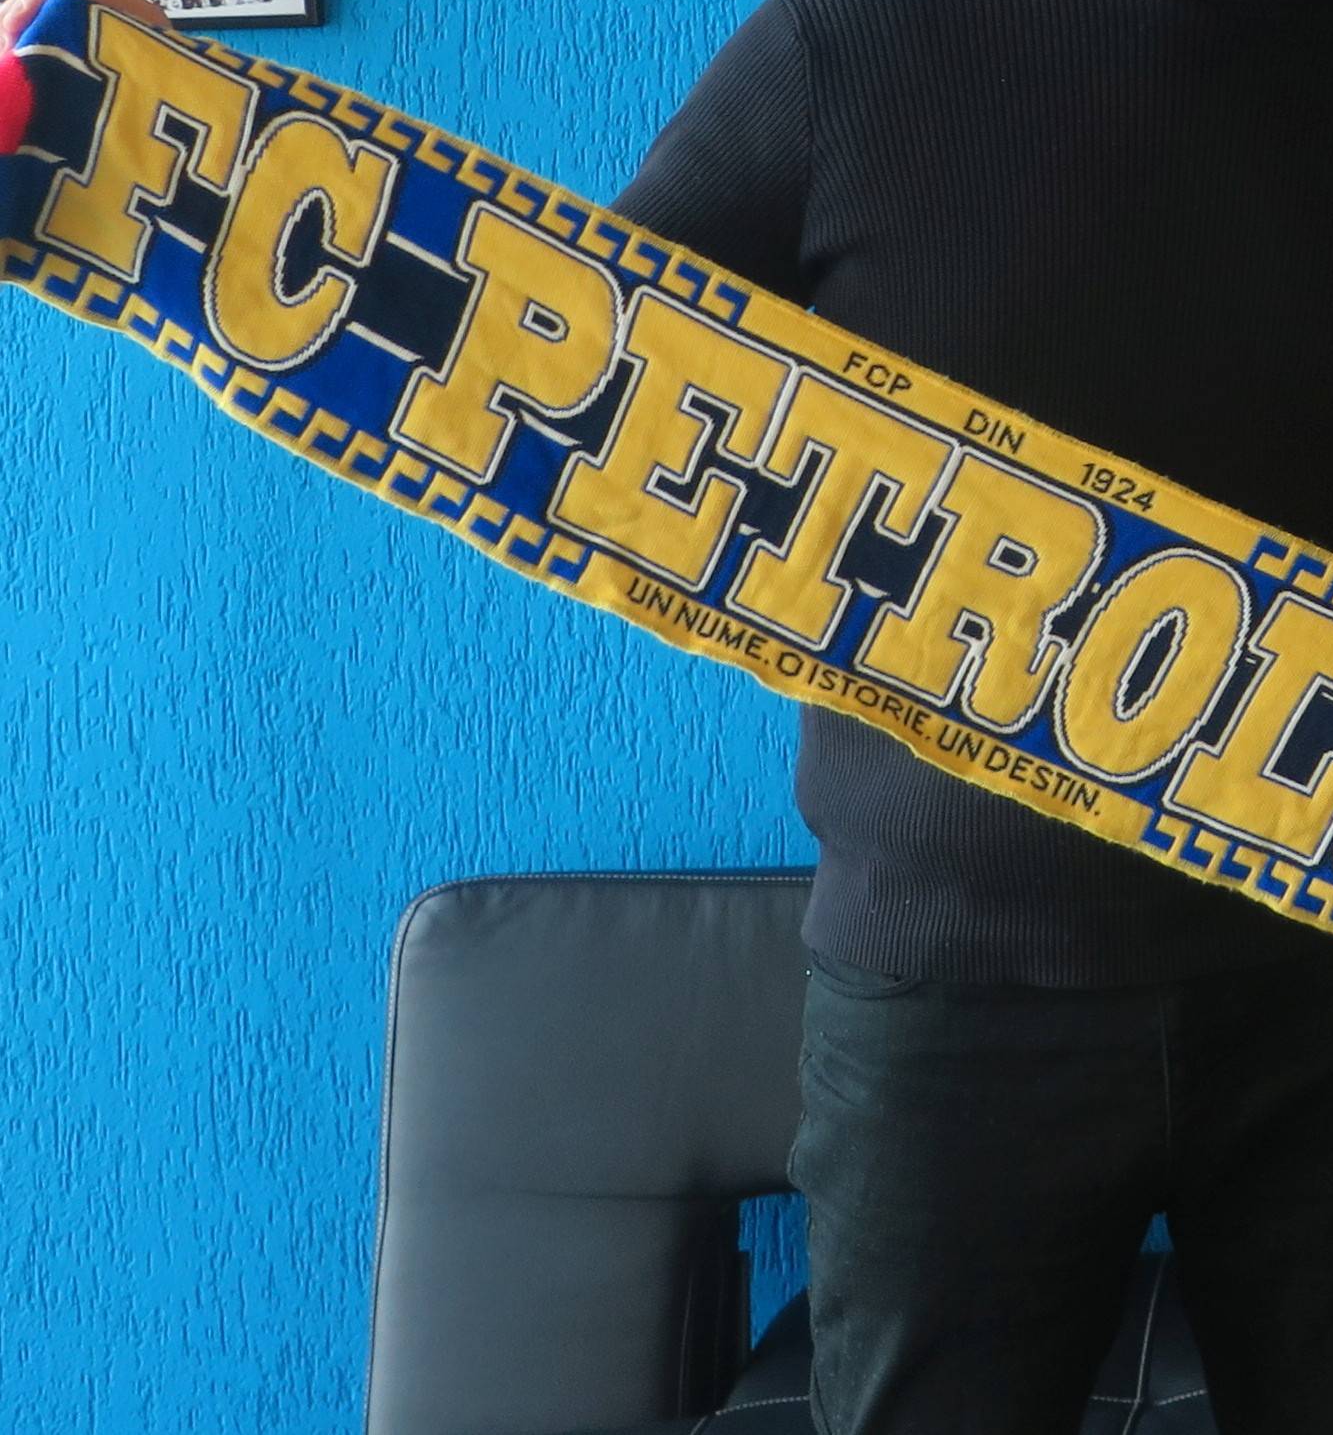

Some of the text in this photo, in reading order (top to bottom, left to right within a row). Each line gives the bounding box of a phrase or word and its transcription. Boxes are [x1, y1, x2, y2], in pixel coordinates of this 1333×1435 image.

[36, 5, 398, 372] FC
[841, 350, 1158, 513] FCP DIN 1924
[625, 575, 675, 617] UN
[774, 650, 804, 678] O
[938, 724, 987, 763] UN
